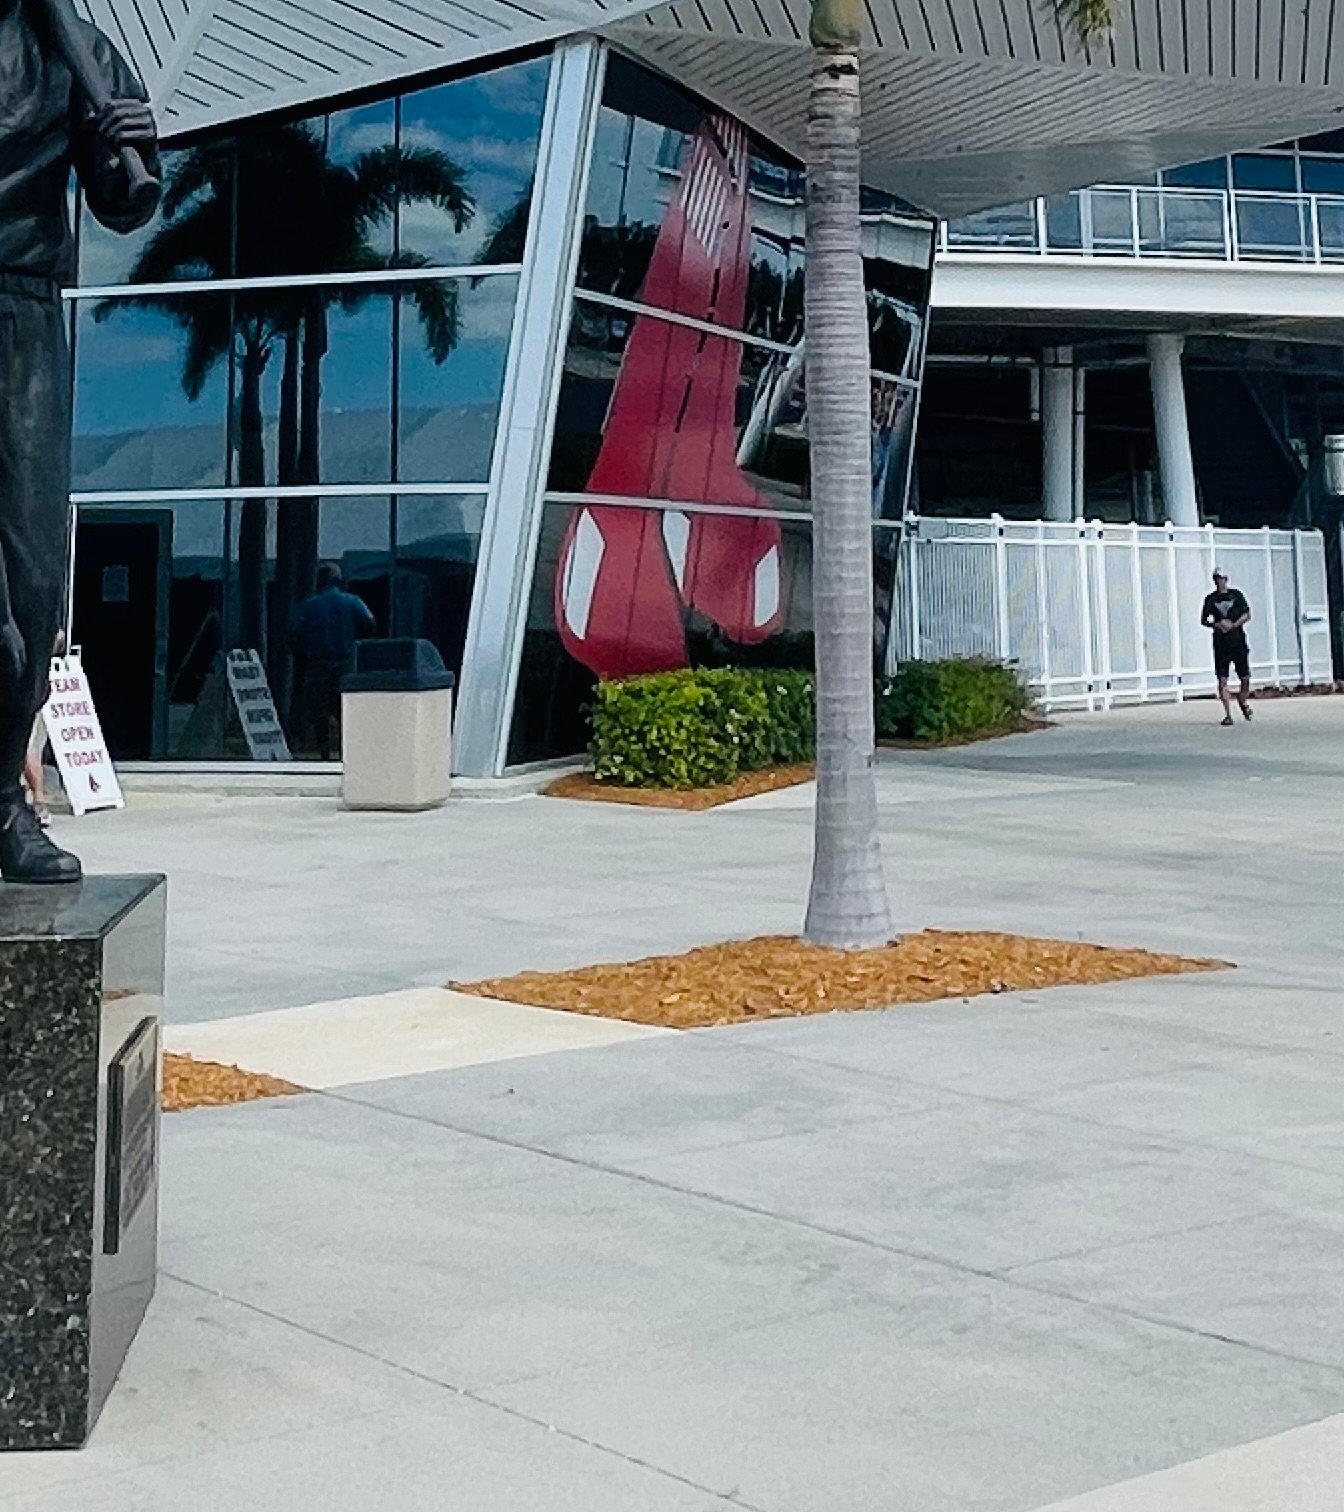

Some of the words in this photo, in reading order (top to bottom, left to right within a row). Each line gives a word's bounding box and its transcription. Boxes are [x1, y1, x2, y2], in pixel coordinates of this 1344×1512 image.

[50, 701, 91, 719] STORE
[61, 727, 95, 742] OPEN
[63, 751, 103, 768] TODAY
